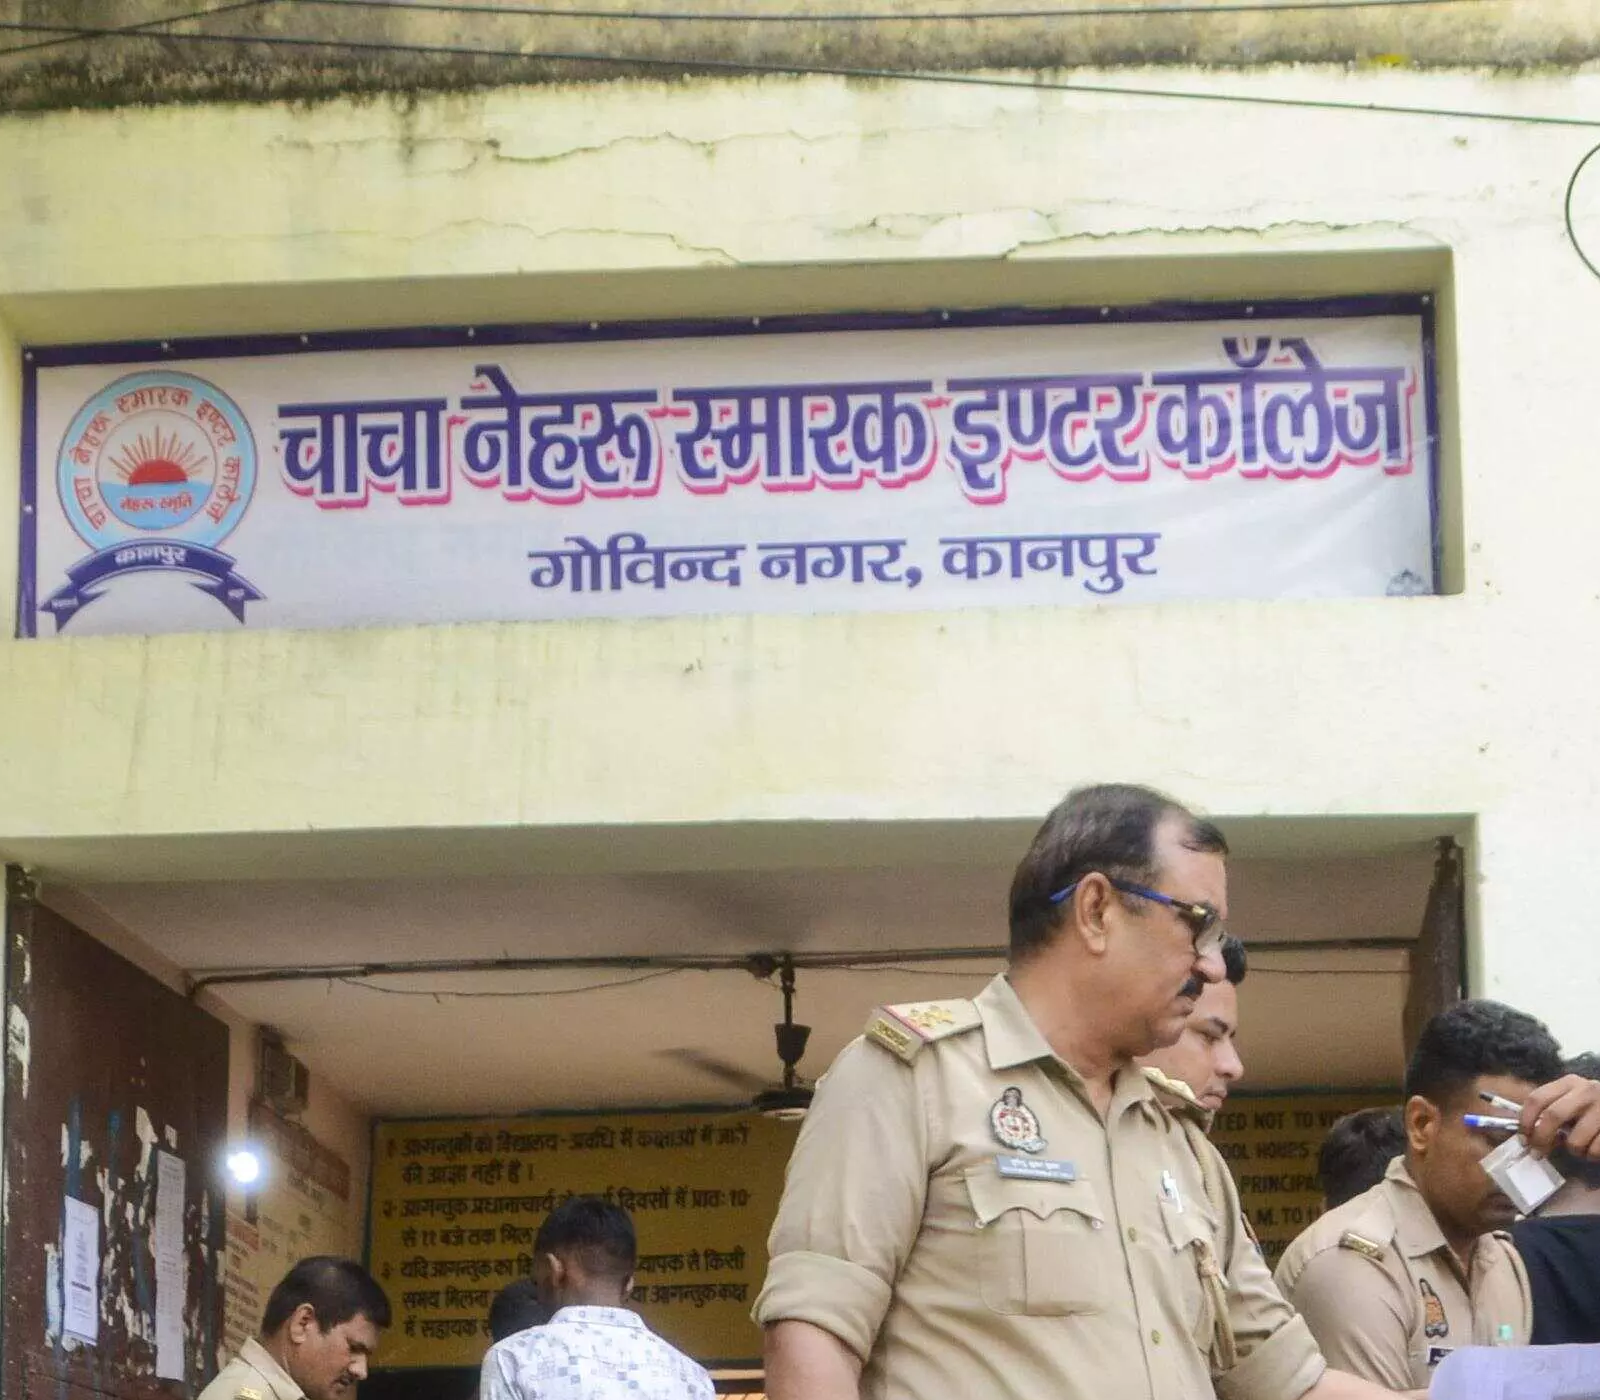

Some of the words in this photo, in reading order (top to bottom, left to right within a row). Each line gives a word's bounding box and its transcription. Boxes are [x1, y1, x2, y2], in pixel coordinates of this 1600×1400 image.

[277, 397, 451, 504] चाचा
[460, 363, 660, 500] नेहरू
[672, 378, 938, 489] स्मारक
[946, 372, 1148, 500] इण्टर
[1152, 336, 1412, 474] कॉलेज
[114, 546, 188, 565] कानपुर
[527, 532, 746, 592] गोविन्द
[757, 538, 923, 589] नगर,
[938, 531, 1162, 595] कानपुर
[1215, 1112, 1248, 1131] TED
[1254, 1110, 1286, 1130] NOT
[1293, 1111, 1314, 1129] TO
